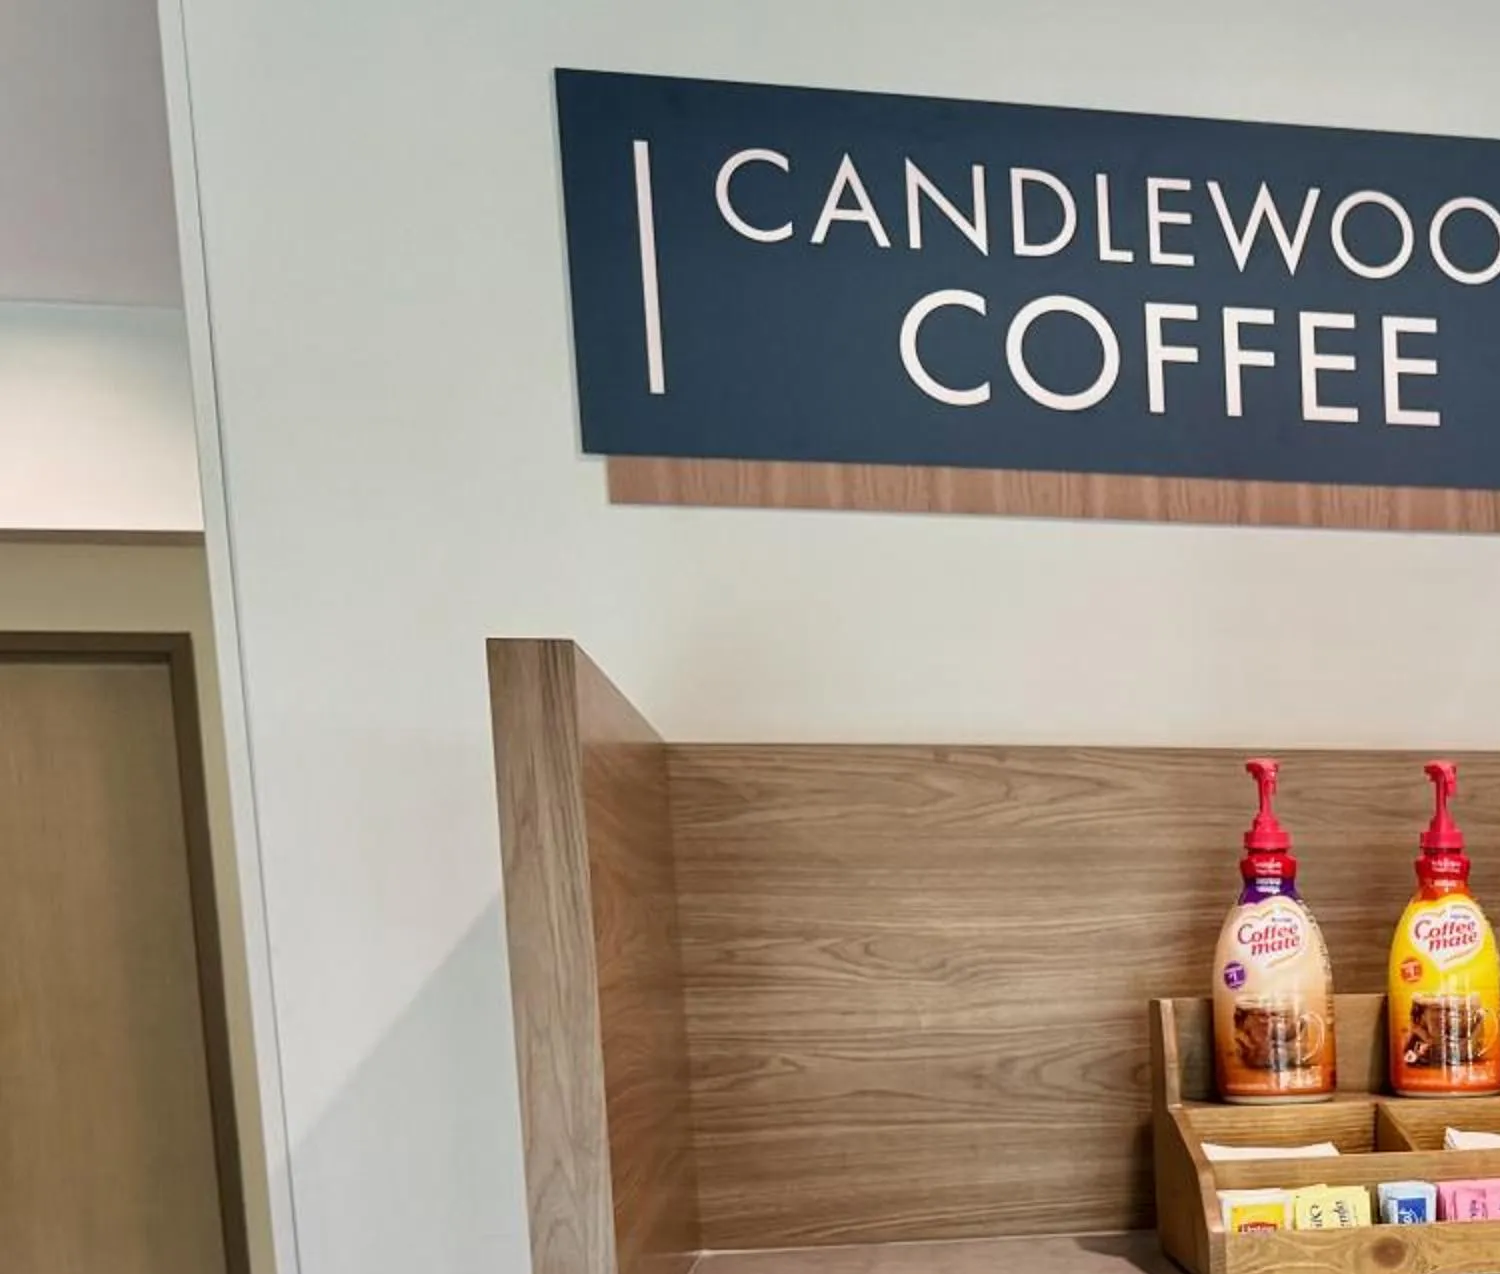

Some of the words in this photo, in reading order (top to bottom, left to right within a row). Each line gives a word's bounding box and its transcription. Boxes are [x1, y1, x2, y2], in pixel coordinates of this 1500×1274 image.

[899, 288, 1440, 427] COFFEE
[1237, 923, 1298, 945] Coffee
[1414, 919, 1475, 941] Coffee
[1251, 935, 1300, 956] mate
[1428, 931, 1477, 952] mate
